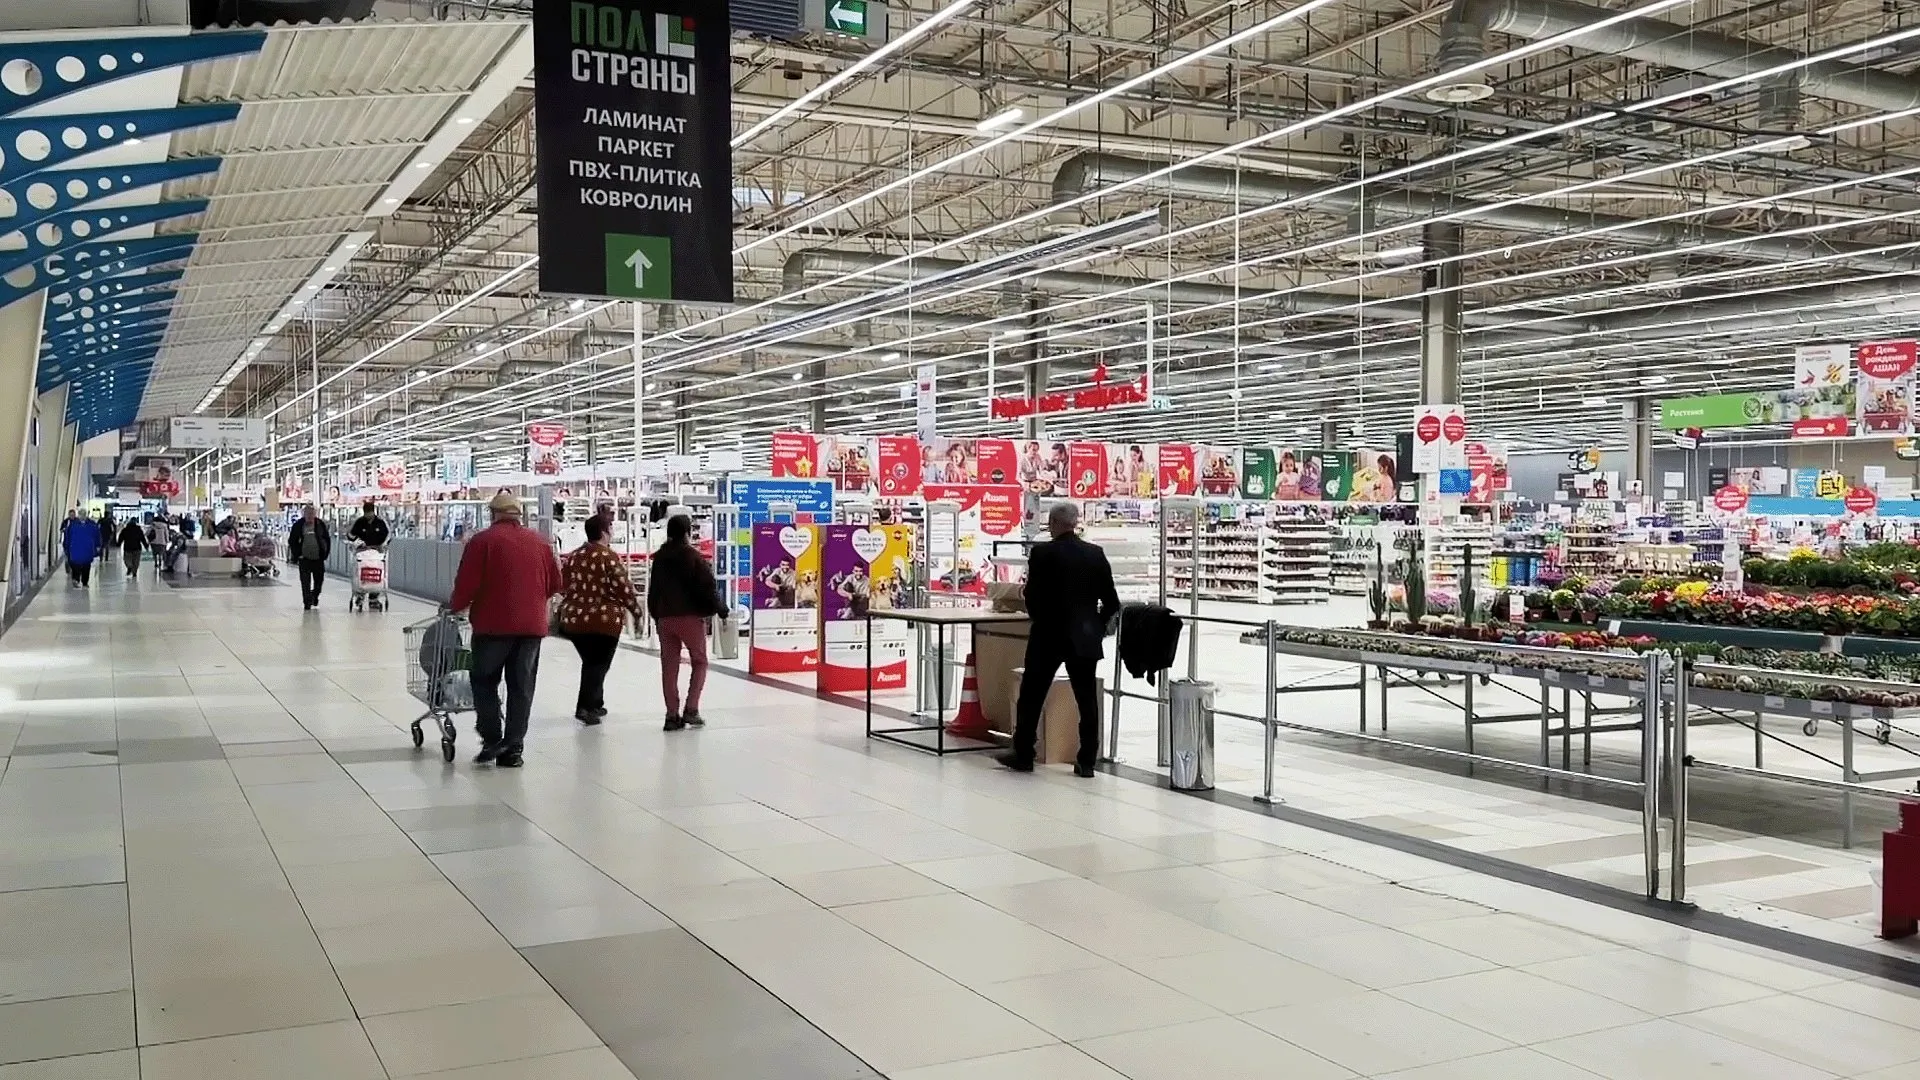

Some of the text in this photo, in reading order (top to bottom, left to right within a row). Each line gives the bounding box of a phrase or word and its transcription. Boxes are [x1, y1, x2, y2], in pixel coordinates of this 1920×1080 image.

[571, 2, 648, 51] ПОЛ
[583, 107, 687, 134] ЛАМИНАТ
[598, 136, 675, 159] ПАРКЕТ
[569, 160, 702, 189] ПВХ-ПЛИТКА
[580, 188, 692, 214] КОВРОЛИН
[1865, 354, 1908, 365] рождения
[1875, 346, 1897, 355] День
[1872, 363, 1901, 373] АШАН
[1670, 408, 1704, 417] Растения
